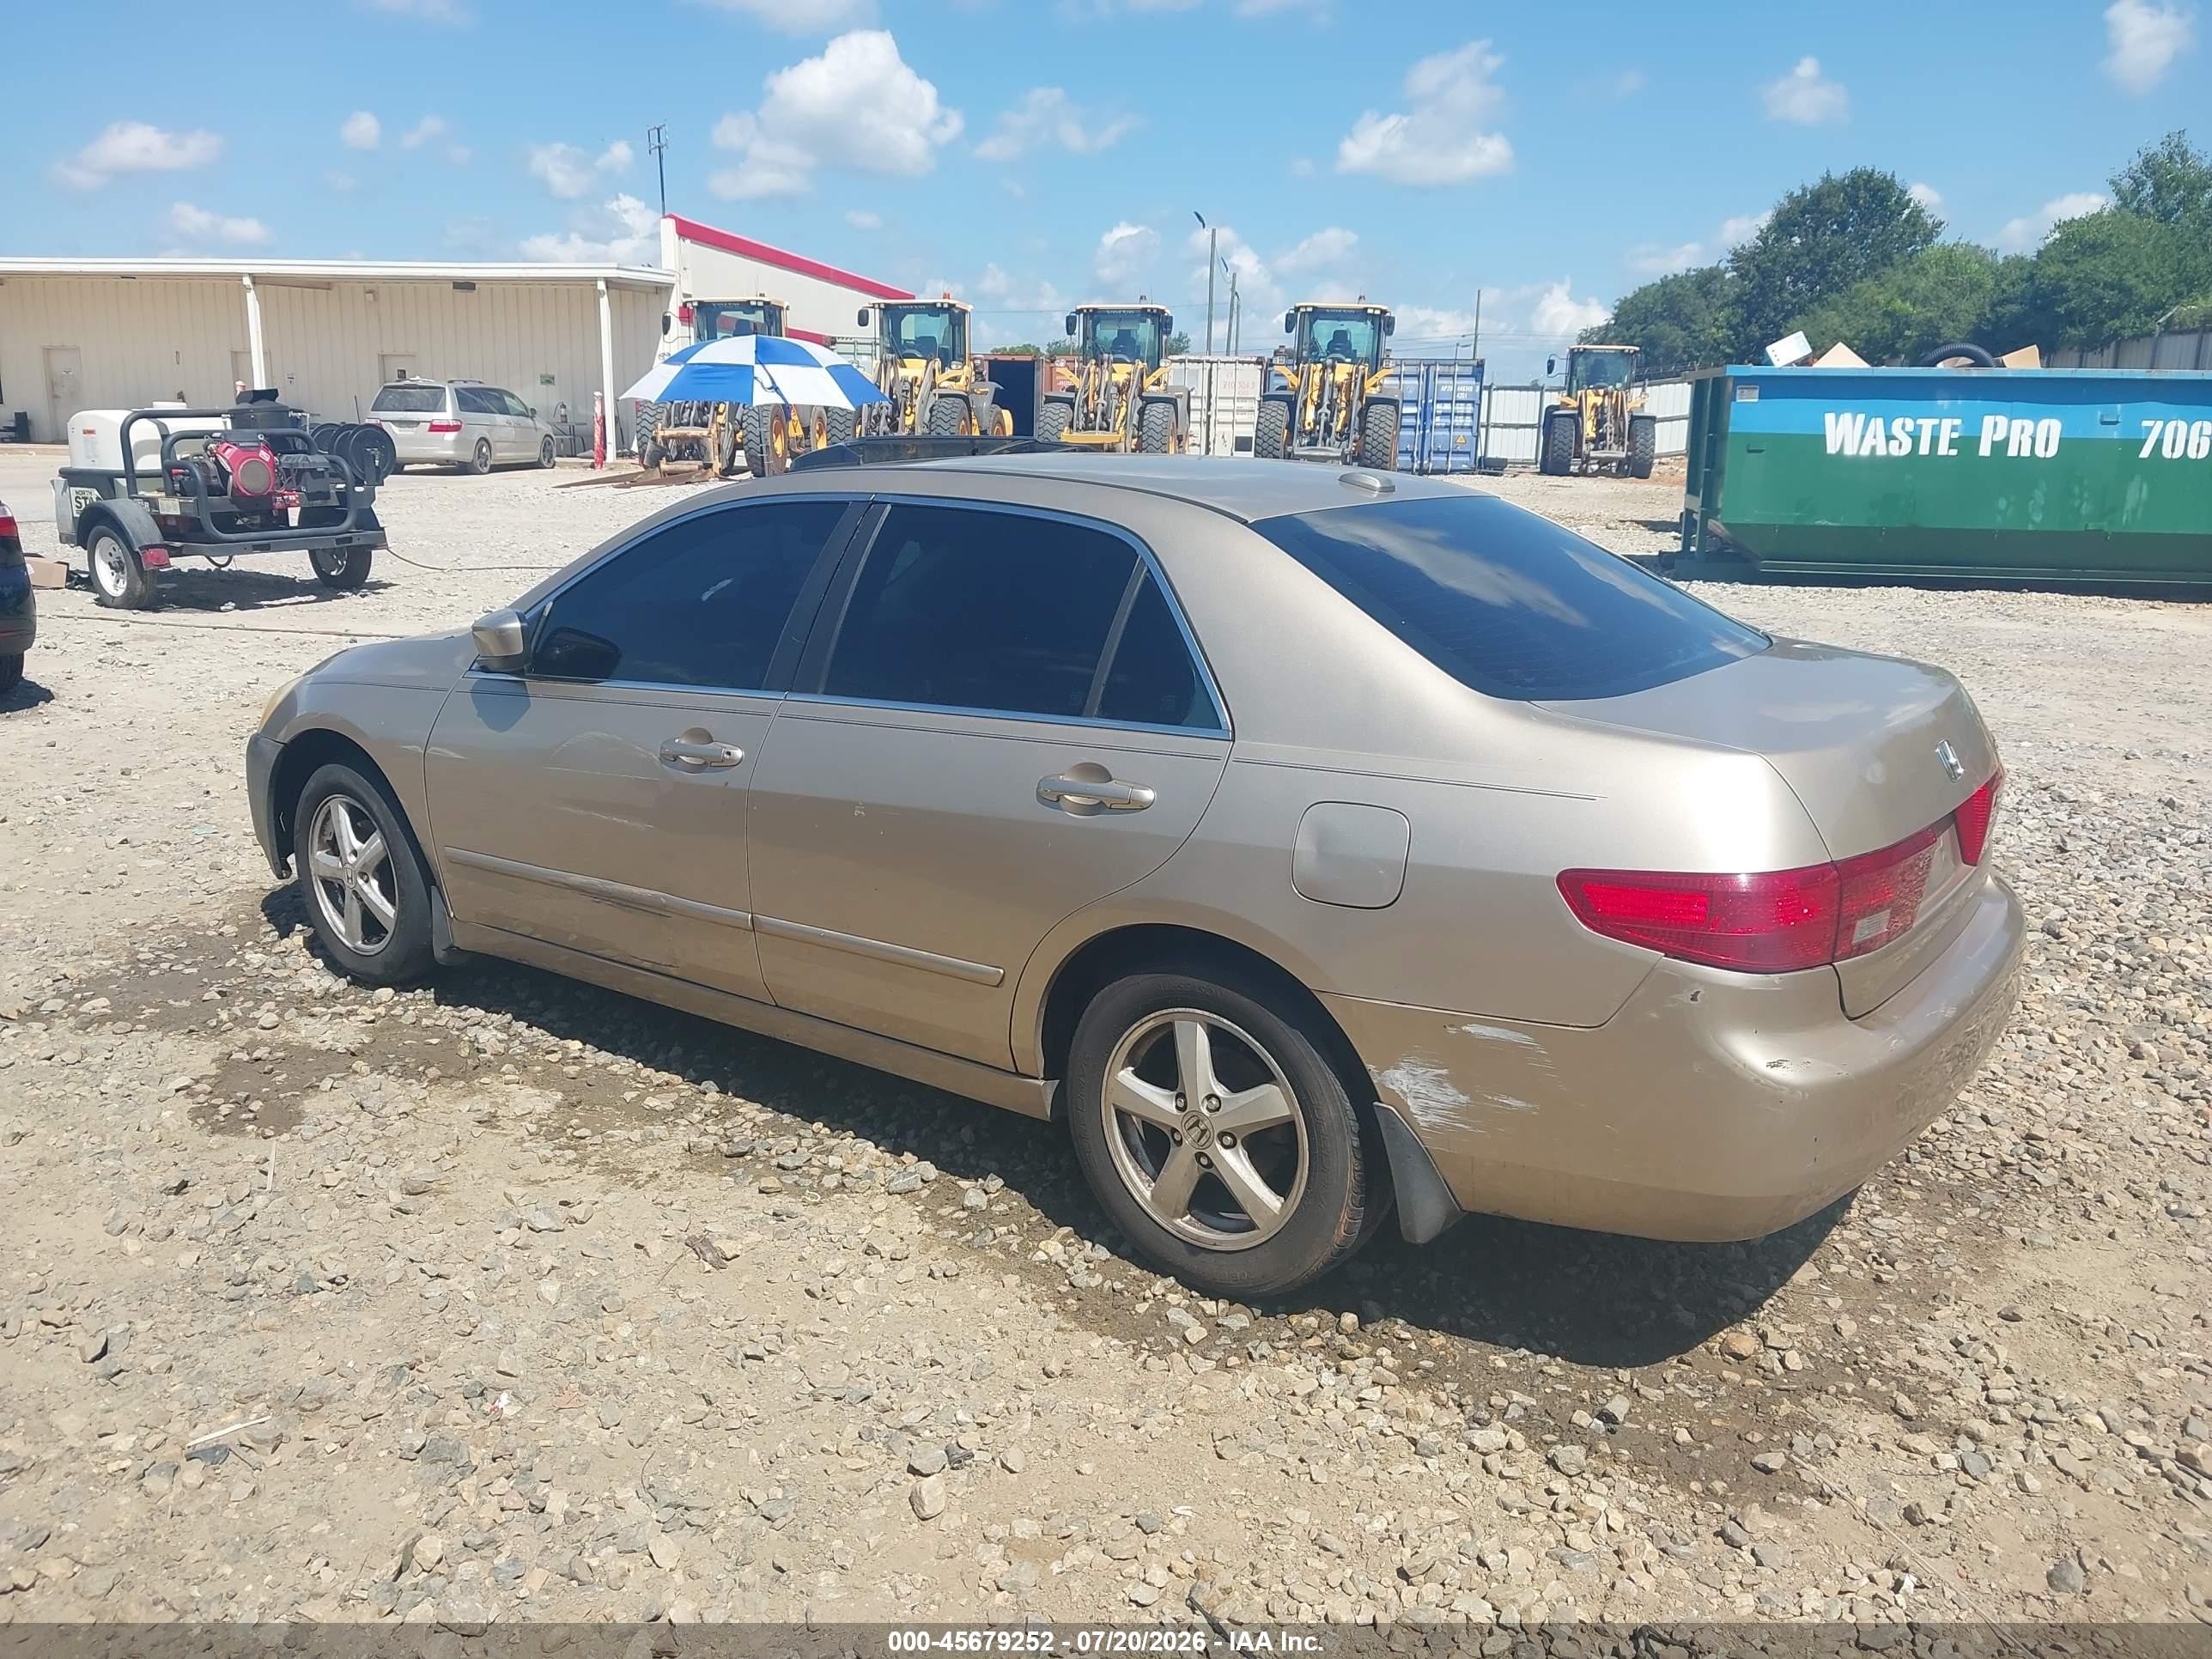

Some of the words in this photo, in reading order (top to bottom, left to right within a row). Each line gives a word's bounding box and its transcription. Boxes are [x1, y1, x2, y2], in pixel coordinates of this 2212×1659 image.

[1824, 412, 1962, 457] WASTE
[1978, 415, 2062, 459] PRO
[2138, 420, 2212, 459] 706
